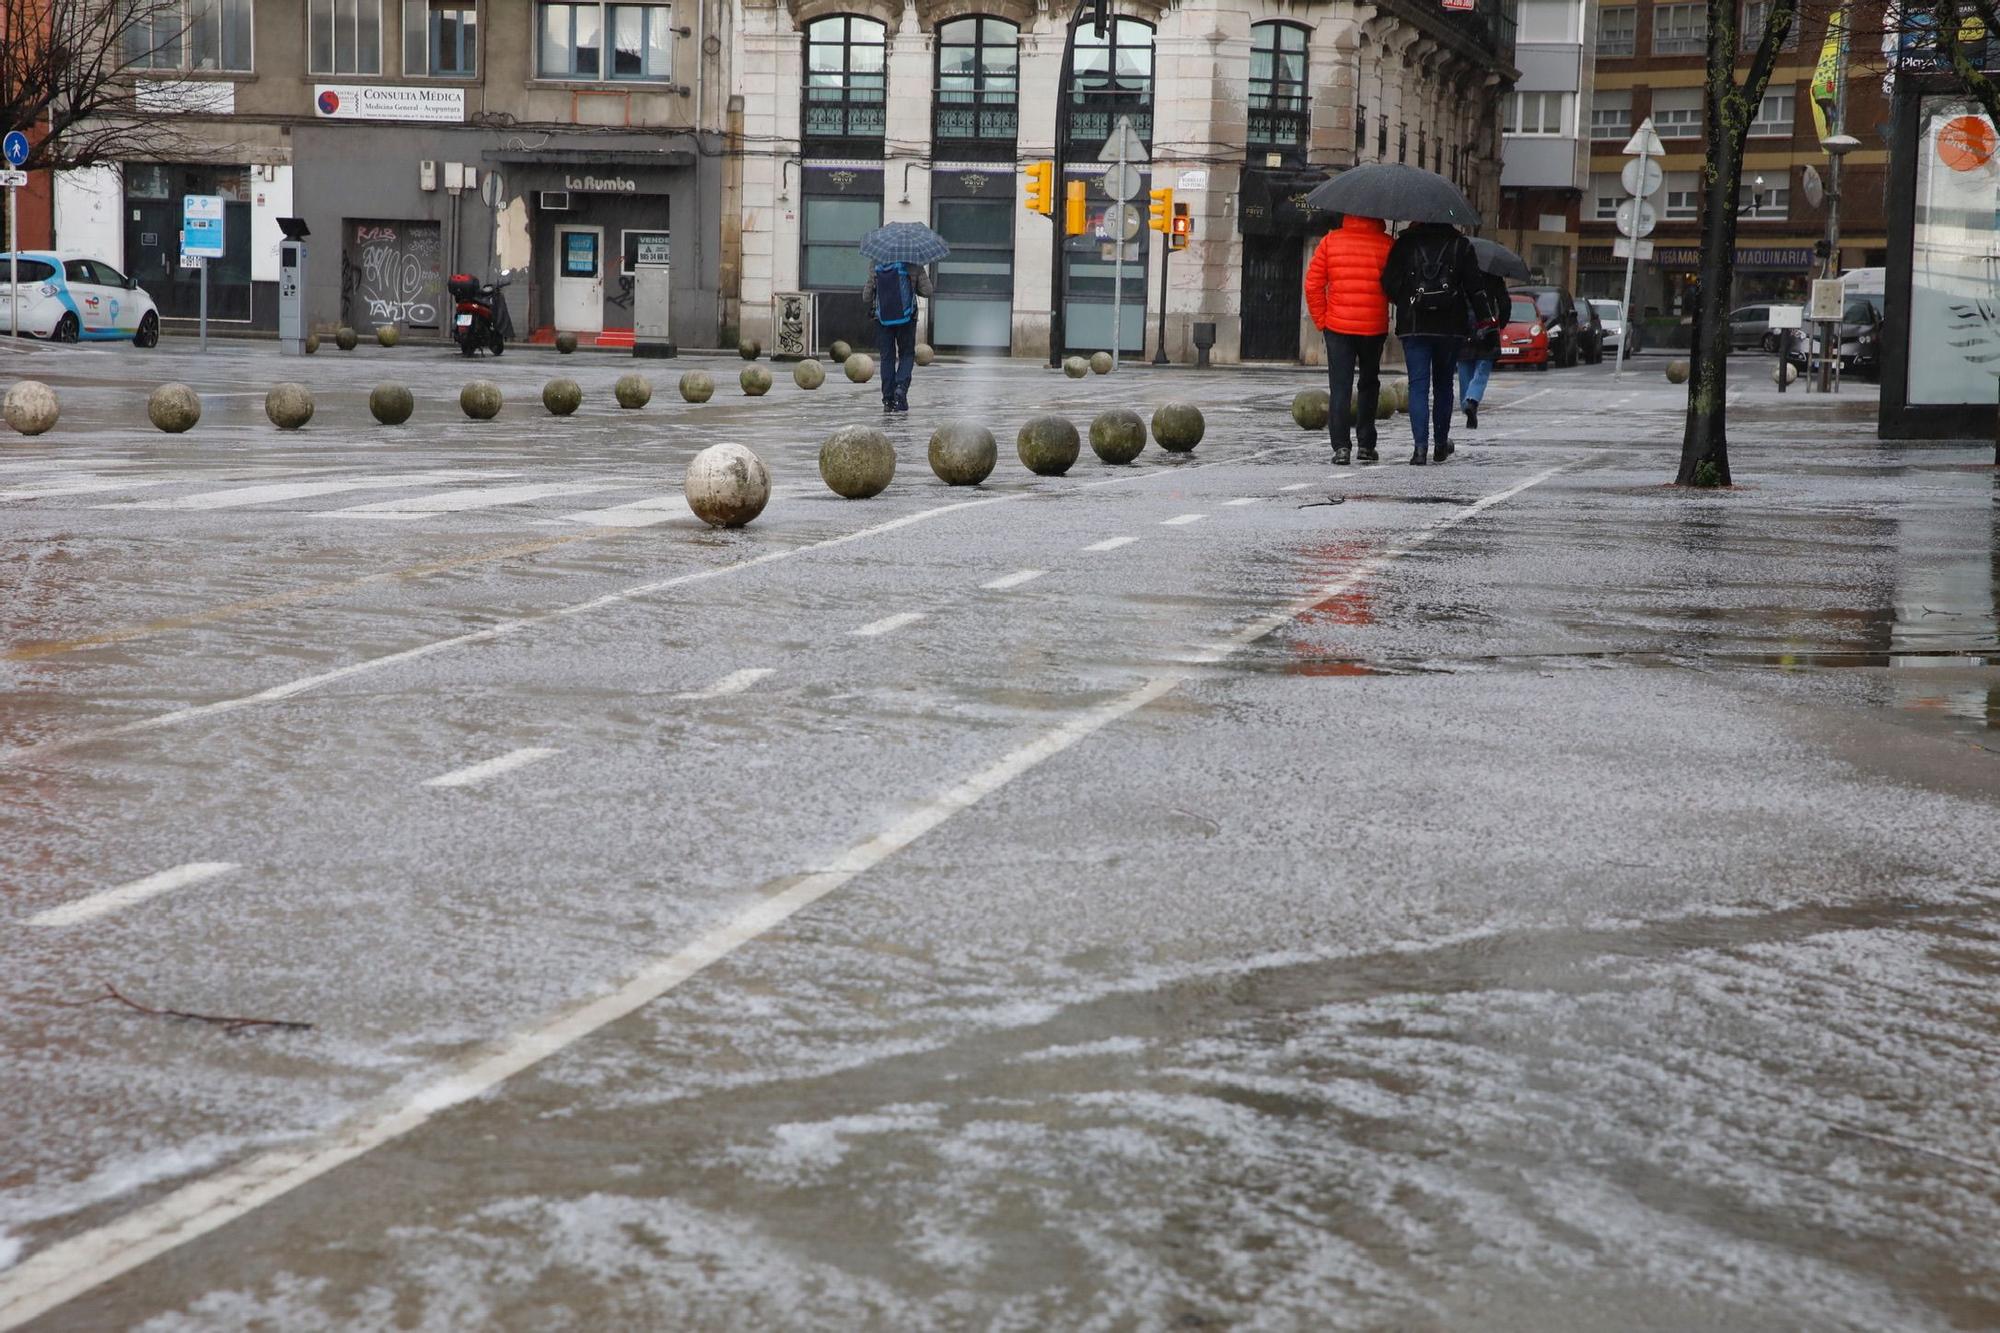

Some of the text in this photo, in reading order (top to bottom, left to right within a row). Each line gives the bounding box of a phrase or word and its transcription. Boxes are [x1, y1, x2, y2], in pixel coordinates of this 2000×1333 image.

[363, 89, 462, 102] CONSULTA MÉDICA
[364, 103, 394, 112] Medicina
[424, 106, 461, 114] Acupuntura
[565, 175, 636, 191] La Rumba
[187, 198, 195, 209] P
[1736, 250, 1809, 265] MAQUINARIA
